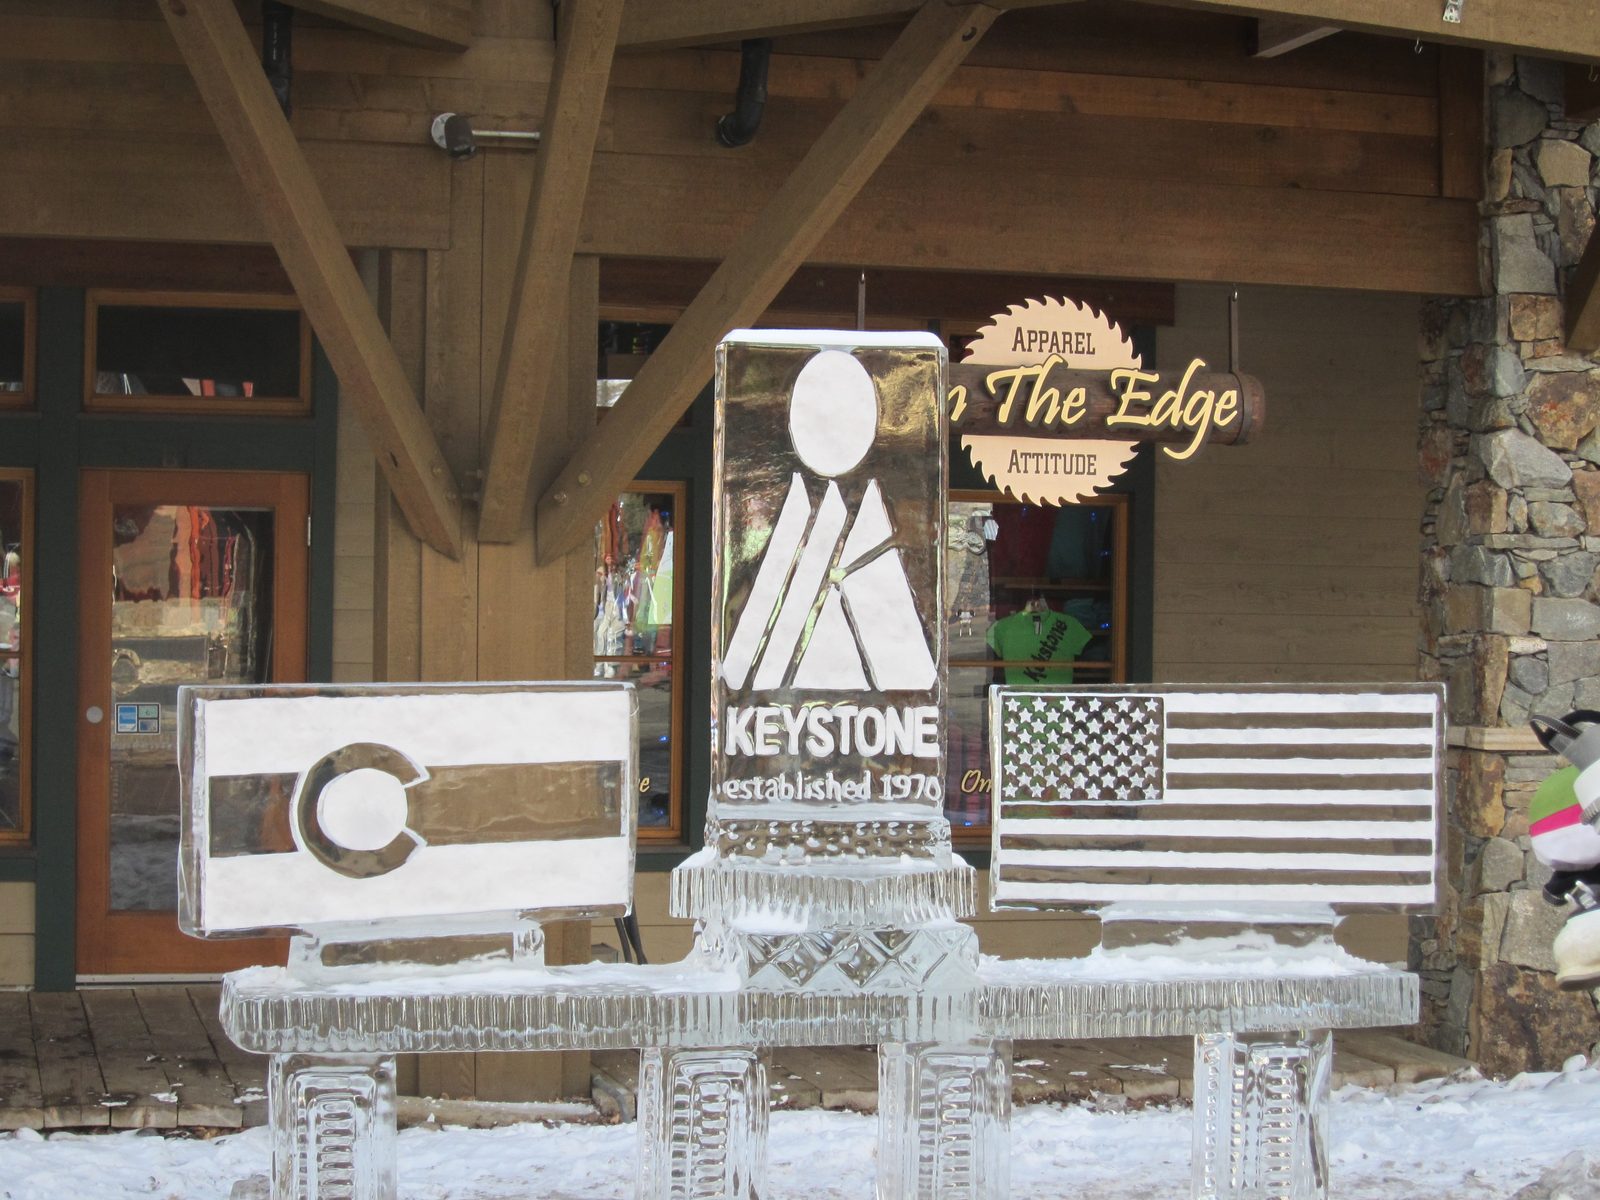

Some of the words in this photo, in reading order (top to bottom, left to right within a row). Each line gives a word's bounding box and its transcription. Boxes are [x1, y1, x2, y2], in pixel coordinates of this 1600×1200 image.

[1012, 326, 1096, 355] APPAREL
[948, 384, 967, 422] n
[986, 353, 1087, 425] The
[1107, 358, 1238, 460] Edge
[1007, 449, 1097, 475] ATTITUDE
[725, 704, 941, 757] KEYSTONE
[723, 769, 871, 802] established
[879, 773, 942, 800] 1970
